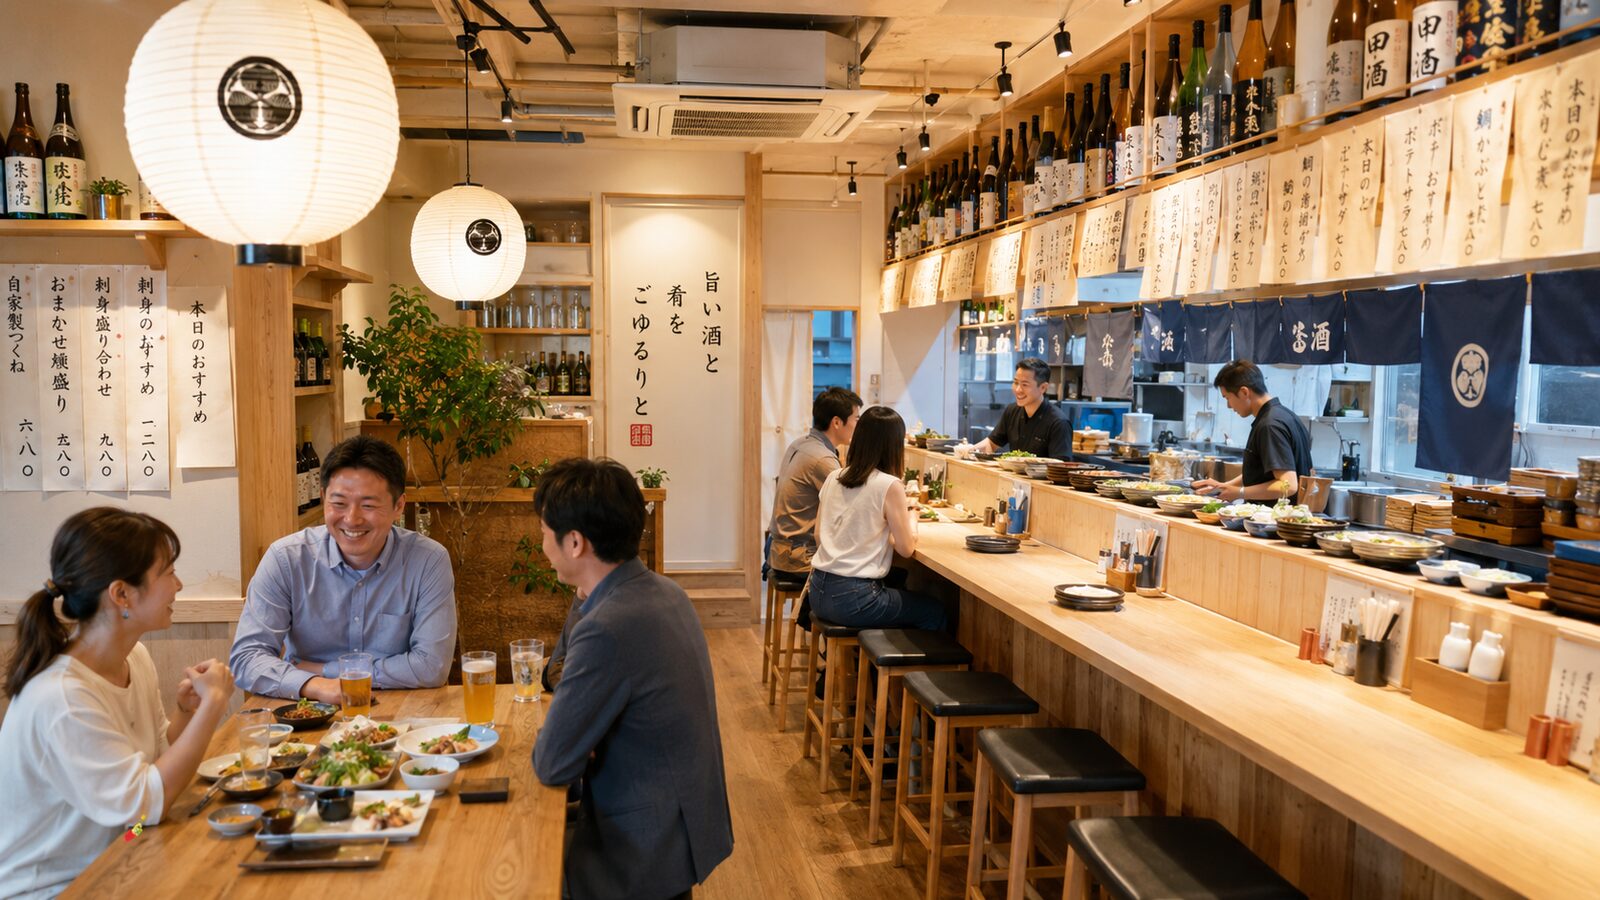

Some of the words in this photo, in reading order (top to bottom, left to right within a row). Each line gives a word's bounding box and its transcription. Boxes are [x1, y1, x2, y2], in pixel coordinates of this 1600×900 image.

[7, 275, 26, 374] 自家製つくね
[94, 276, 113, 397] 刺身盛り合わせ
[189, 300, 208, 424] 本日のおすすめ
[632, 284, 652, 416] ごゆるりと
[666, 284, 687, 335] 肴を
[702, 271, 722, 374] 旨い酒と
